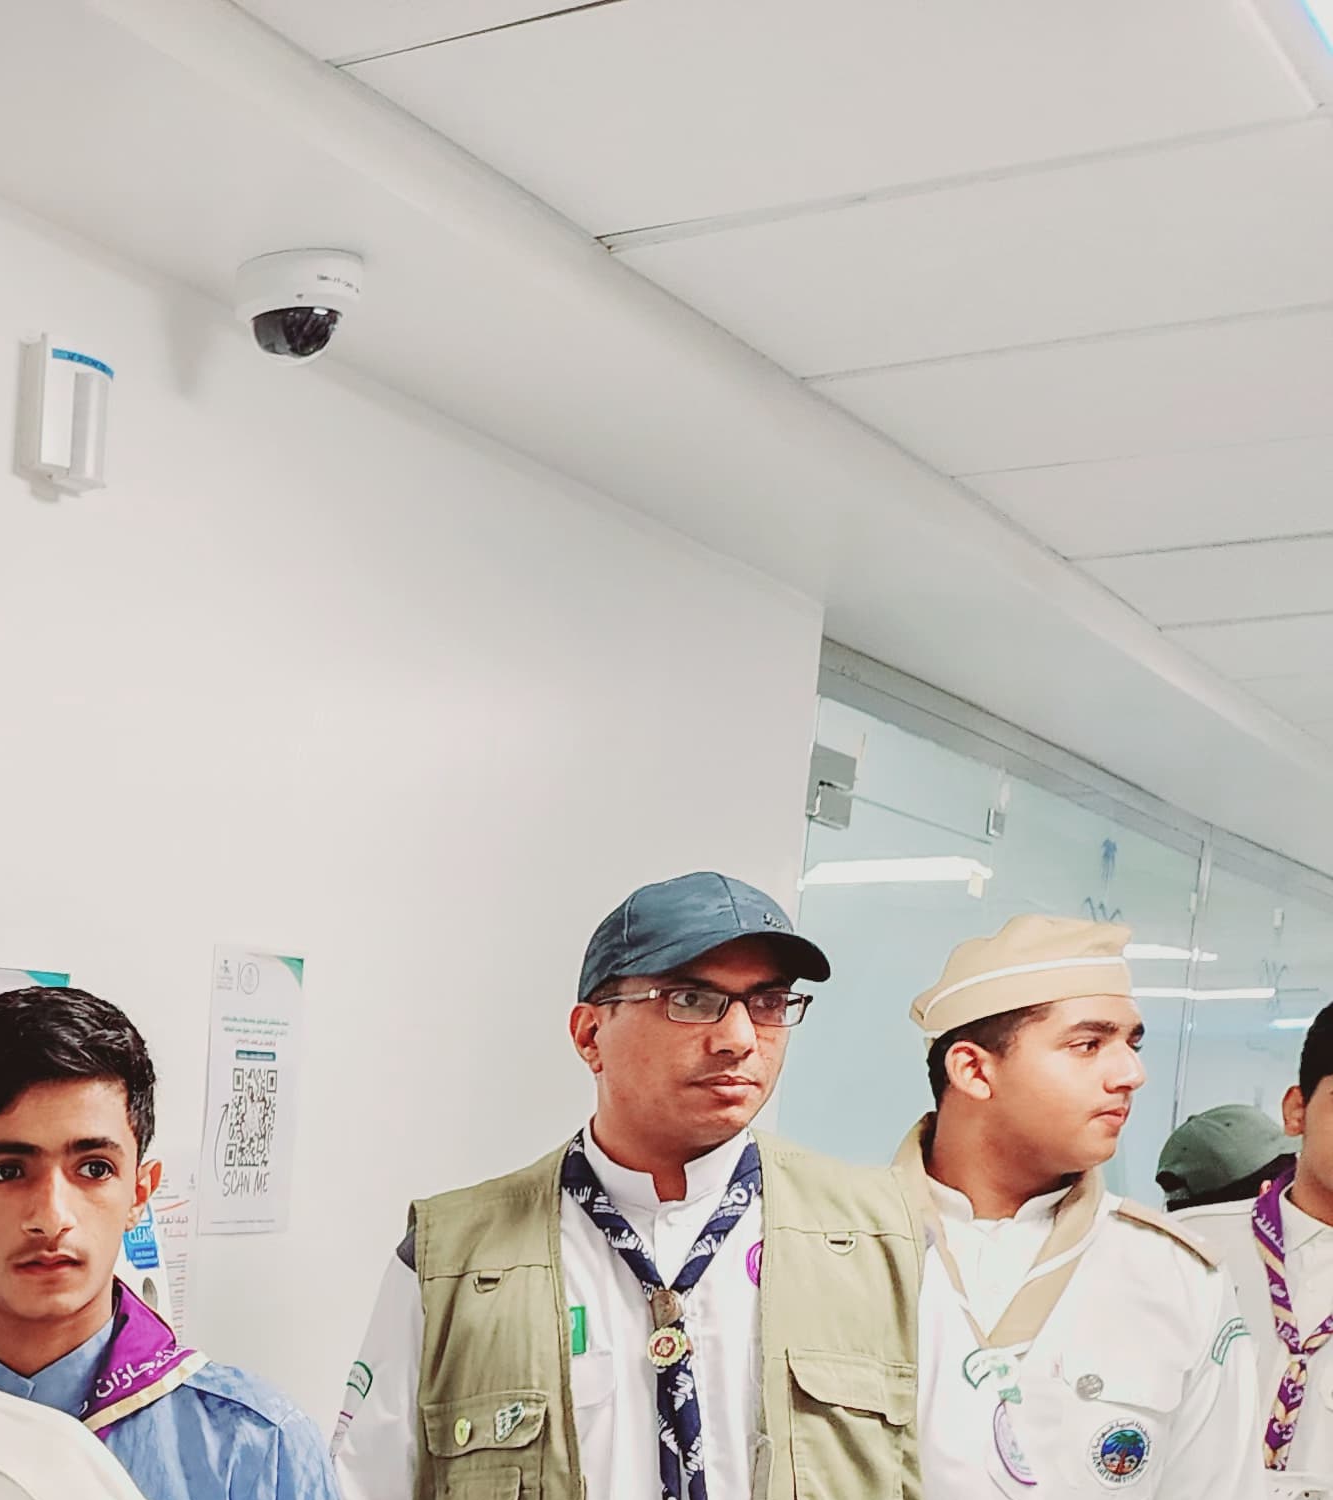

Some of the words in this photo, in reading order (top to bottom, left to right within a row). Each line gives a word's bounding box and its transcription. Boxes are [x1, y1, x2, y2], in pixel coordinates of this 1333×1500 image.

[222, 1169, 251, 1198] SCAN
[253, 1168, 271, 1197] ME
[95, 1362, 155, 1398] جازان
